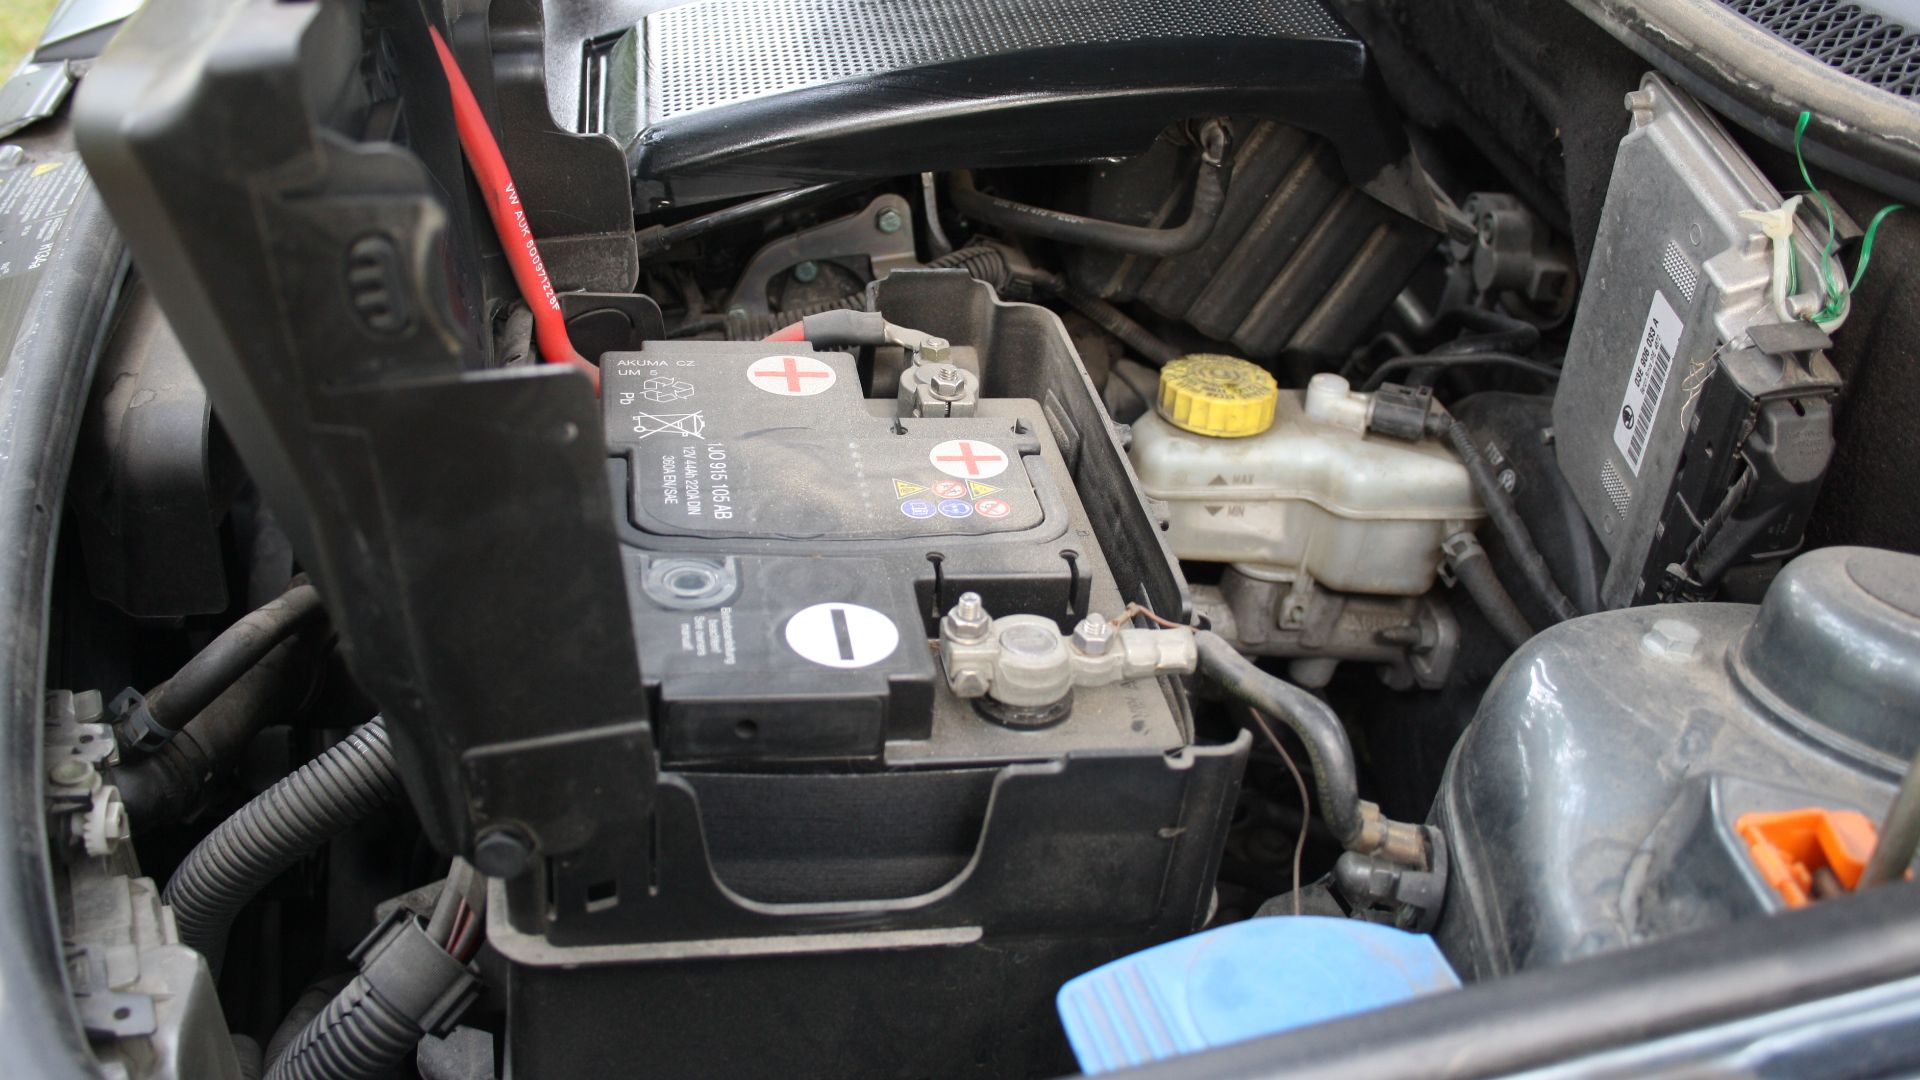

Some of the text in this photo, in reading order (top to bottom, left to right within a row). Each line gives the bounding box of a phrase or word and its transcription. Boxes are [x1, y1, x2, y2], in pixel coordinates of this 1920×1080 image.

[505, 182, 520, 205] VW
[514, 210, 531, 237] AUK
[617, 359, 669, 367] AKUMA
[1640, 347, 1650, 367] 906
[619, 392, 635, 405] Pb
[662, 455, 679, 505] 360A EN/SAE
[709, 462, 728, 480] 915
[1231, 472, 1255, 486] MAX
[682, 446, 702, 515] 12V 44Ah 220A DIN
[711, 484, 731, 503] 105
[713, 504, 733, 519] AB
[1227, 505, 1245, 517] MIN
